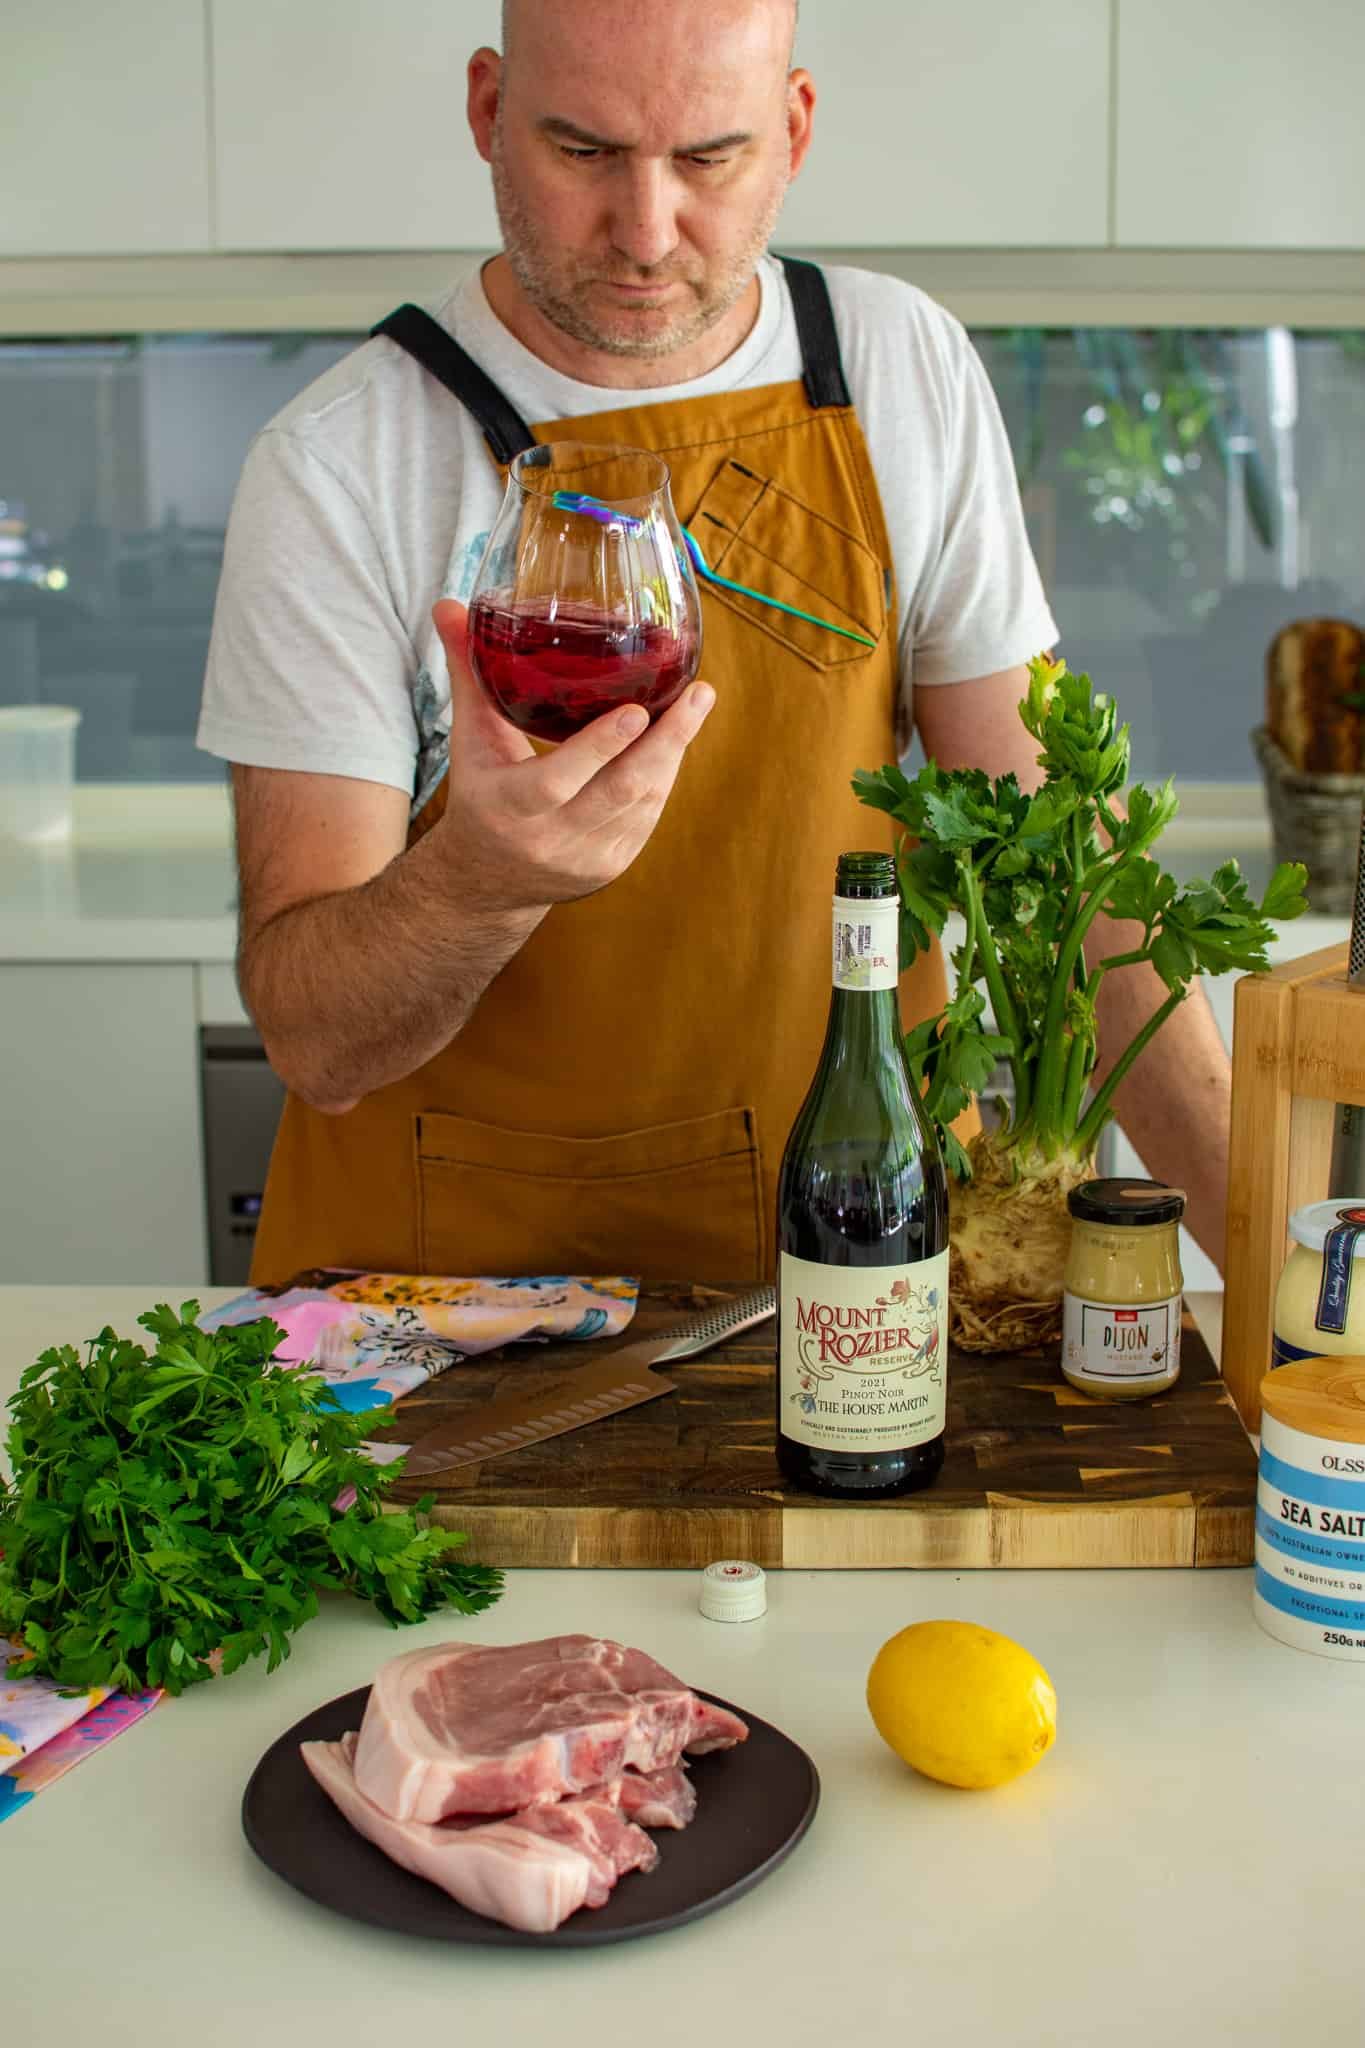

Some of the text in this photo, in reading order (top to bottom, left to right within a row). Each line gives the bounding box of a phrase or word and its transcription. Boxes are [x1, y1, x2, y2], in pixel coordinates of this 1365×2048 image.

[795, 1297, 887, 1334] MOUNT
[818, 1327, 921, 1365] ROZIER
[1104, 1324, 1149, 1352] DIJON
[870, 1353, 914, 1366] RESERVE
[860, 1378, 886, 1388] 2021
[817, 1394, 929, 1416] THE HOUSE MARTIN
[1281, 1498, 1365, 1537] SEA SALT
[1283, 1536, 1332, 1557] AUSTRALIAN
[1284, 1566, 1362, 1591] NO ADDITIVES OR
[1291, 1597, 1349, 1619] EXCEPTIONAL
